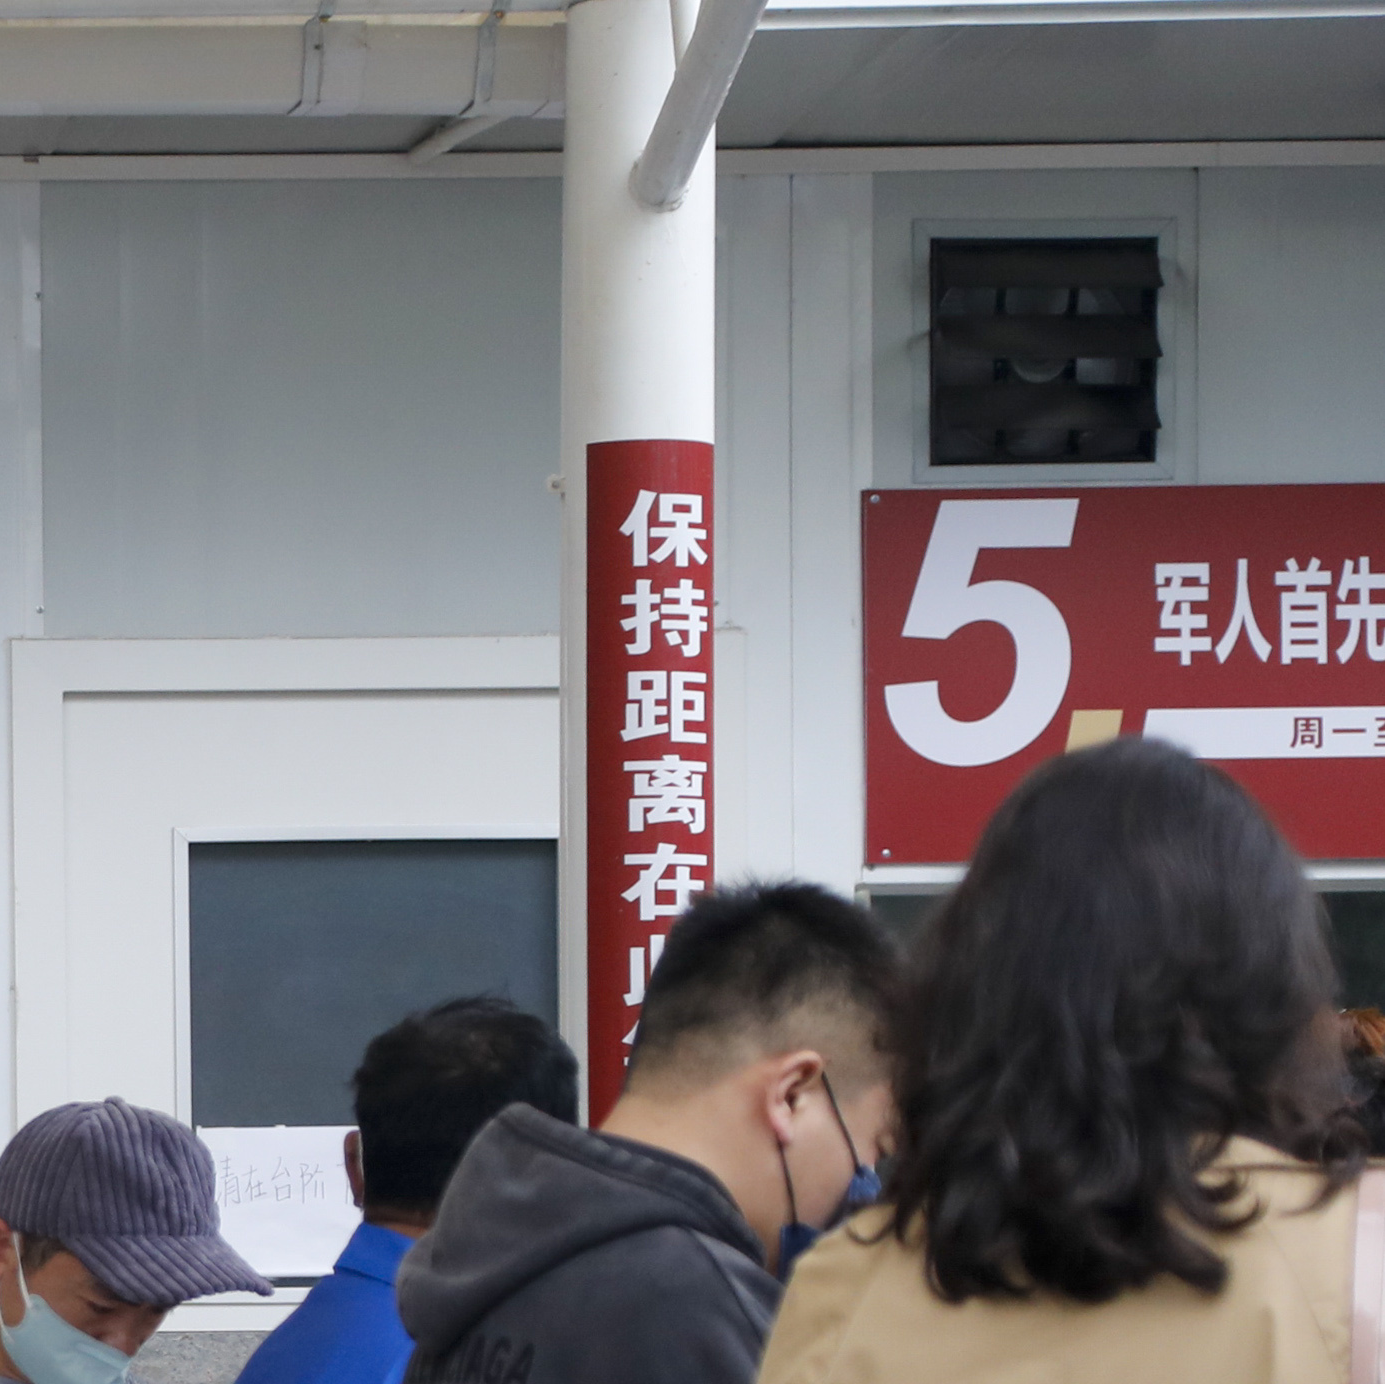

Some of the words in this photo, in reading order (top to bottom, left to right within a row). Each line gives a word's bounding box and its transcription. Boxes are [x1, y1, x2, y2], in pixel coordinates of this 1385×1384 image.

[884, 497, 1080, 767] 5
[1153, 557, 1385, 666] 军人首先
[619, 489, 708, 1066] 保持距离在
[217, 1155, 350, 1207] 请在台阶
